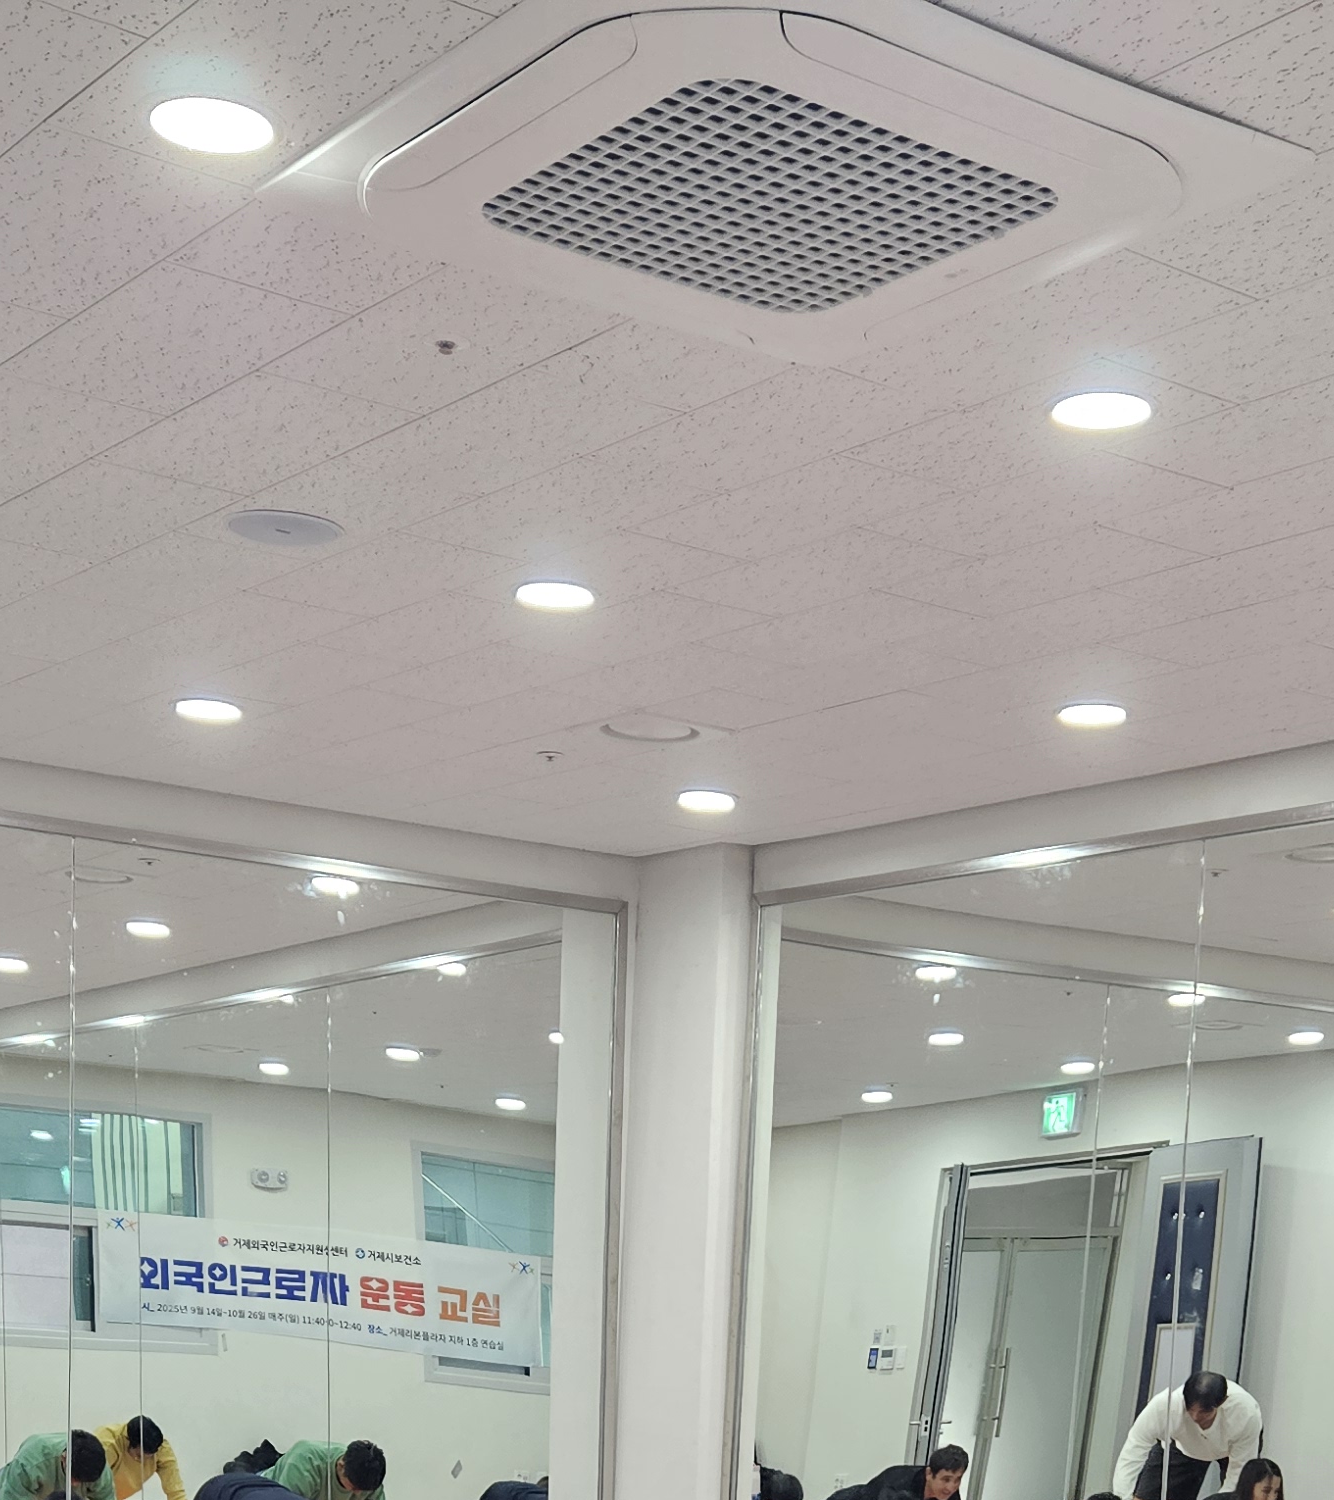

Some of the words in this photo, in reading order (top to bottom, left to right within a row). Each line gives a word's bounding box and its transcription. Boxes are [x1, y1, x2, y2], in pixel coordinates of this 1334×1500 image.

[368, 1249, 422, 1266] 거제시보건소
[359, 1276, 426, 1317] 운동
[437, 1286, 501, 1328] 교실
[157, 1303, 188, 1314] 2025년
[247, 1310, 266, 1321] 26일
[448, 1333, 464, 1346] 지하
[480, 1339, 505, 1351] 연습실
